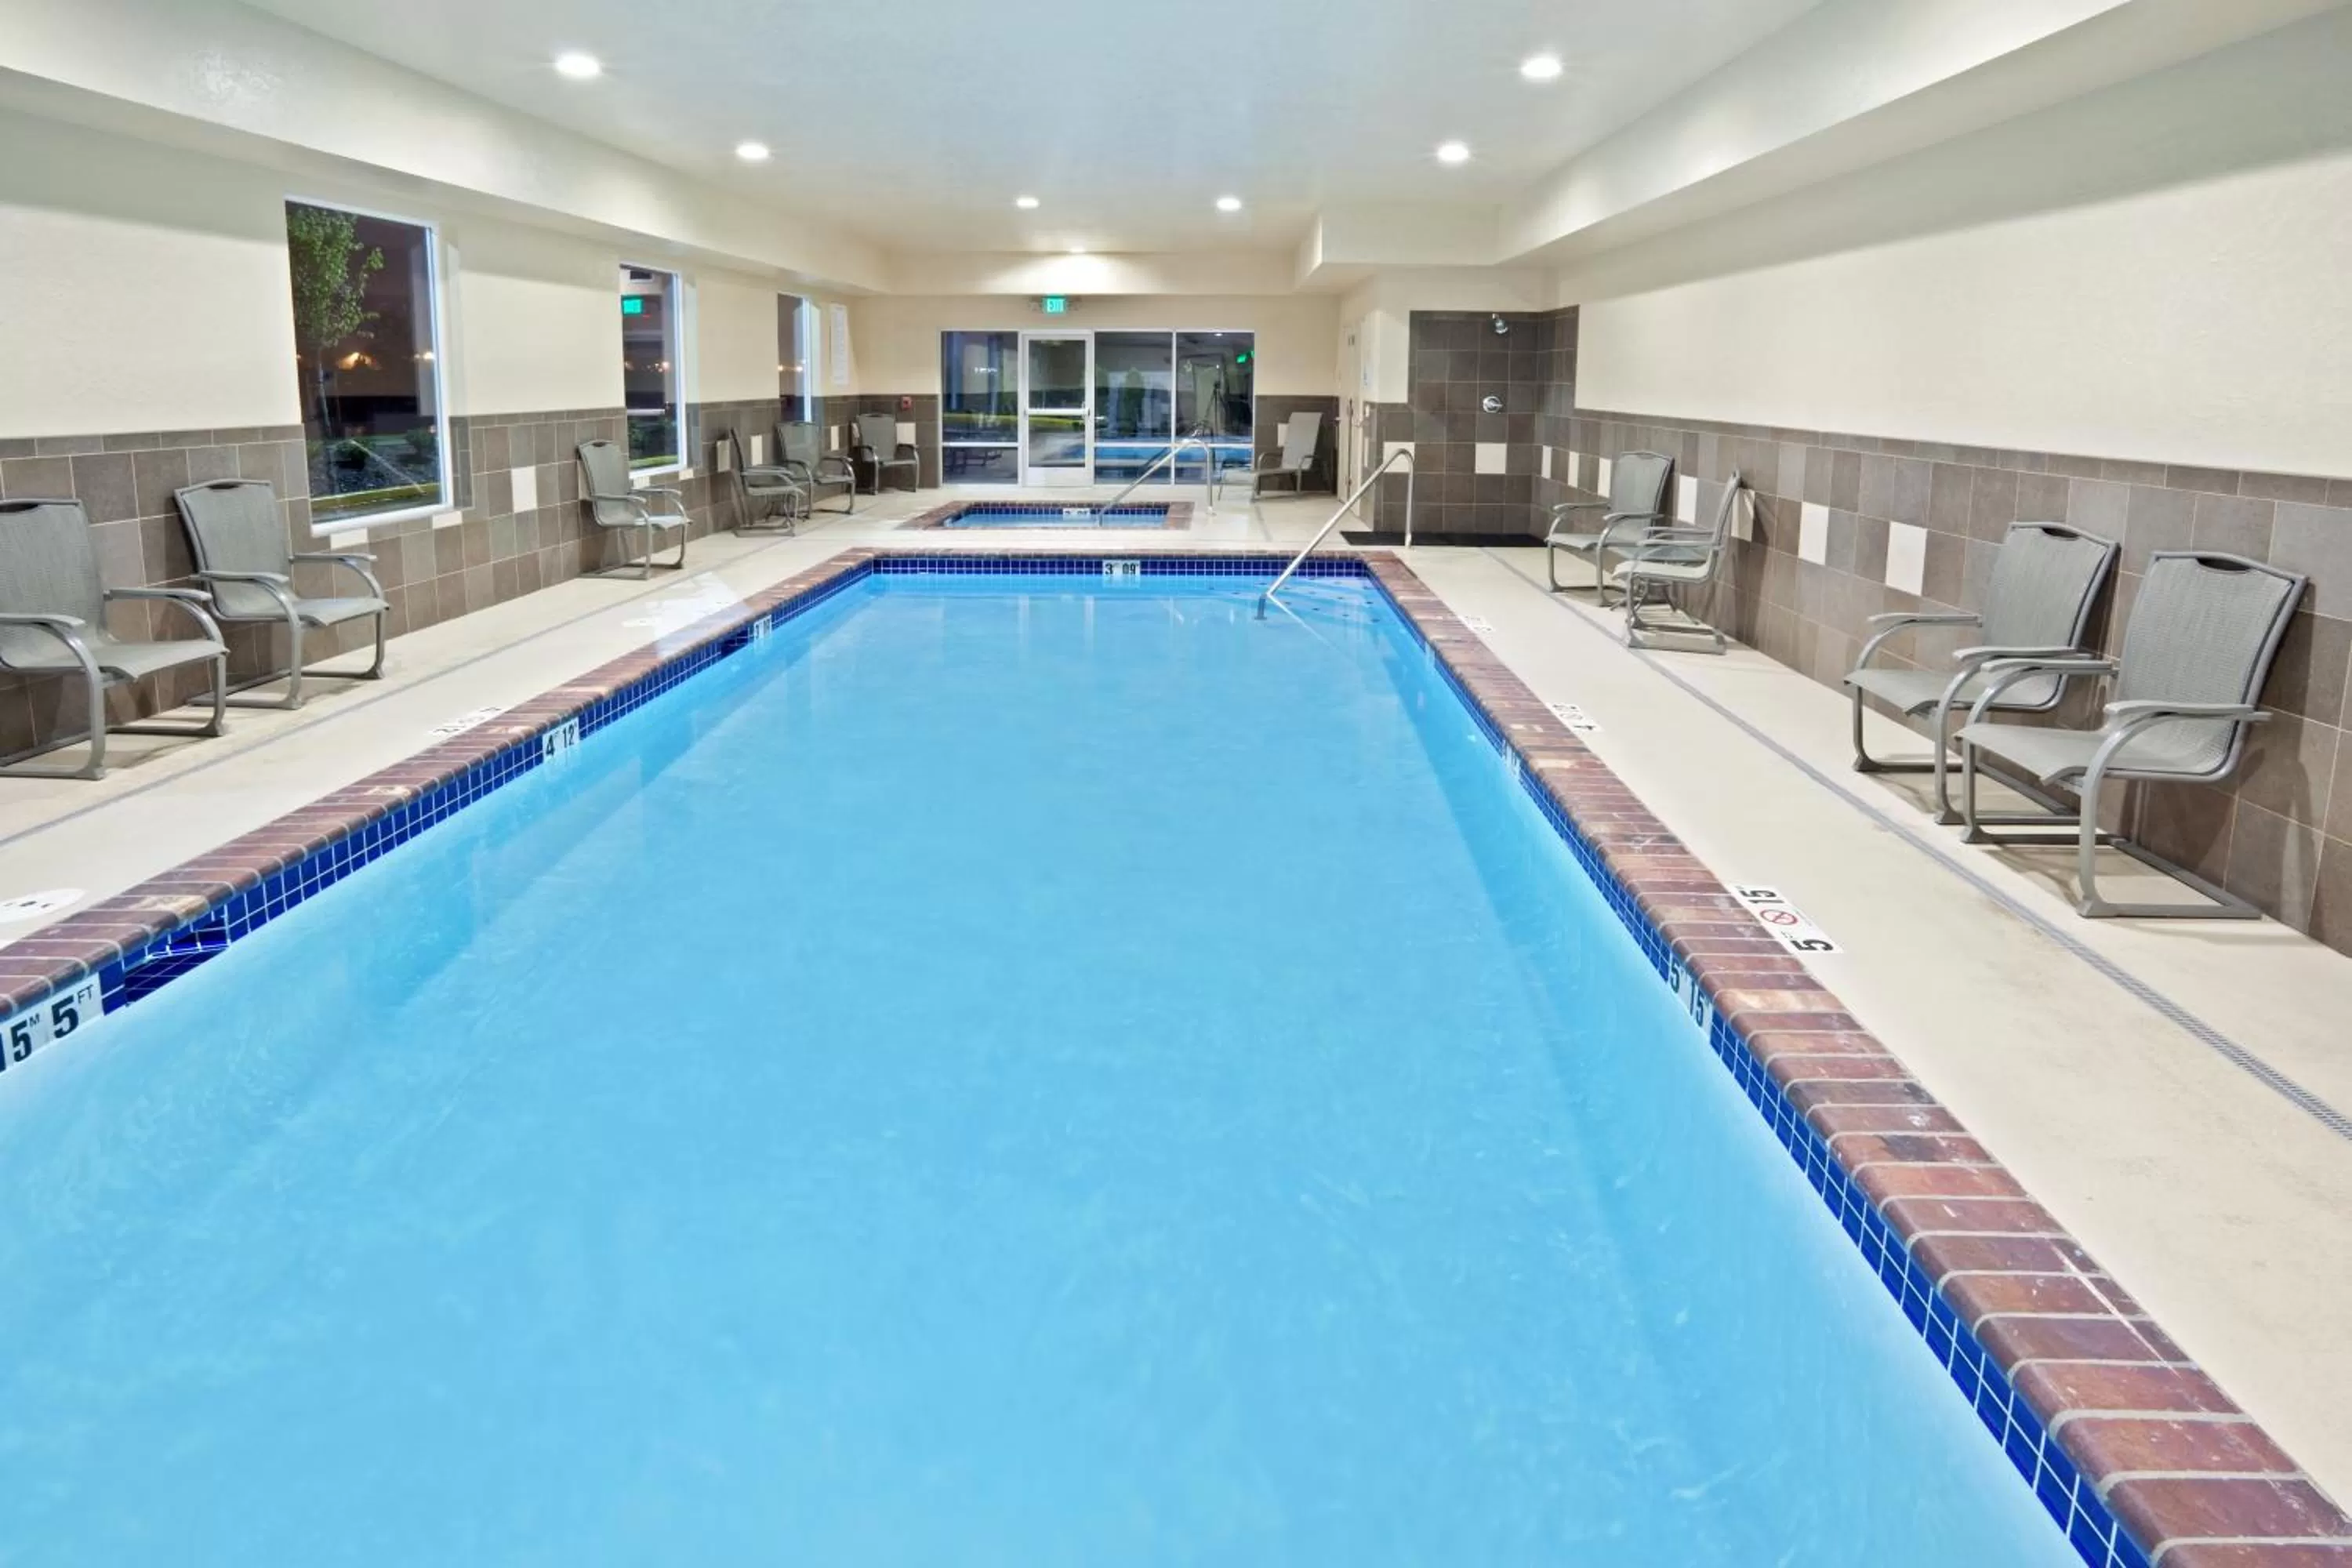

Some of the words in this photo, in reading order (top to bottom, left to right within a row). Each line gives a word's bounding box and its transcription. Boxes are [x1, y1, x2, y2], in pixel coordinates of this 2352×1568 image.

[546, 735, 556, 756] 4
[563, 724, 575, 749] 12
[1739, 890, 1784, 904] 15
[1791, 939, 1834, 951] 5
[1671, 957, 1680, 993] 5
[1690, 978, 1705, 1027] 15
[51, 993, 79, 1039] 5
[76, 984, 93, 1004] FT
